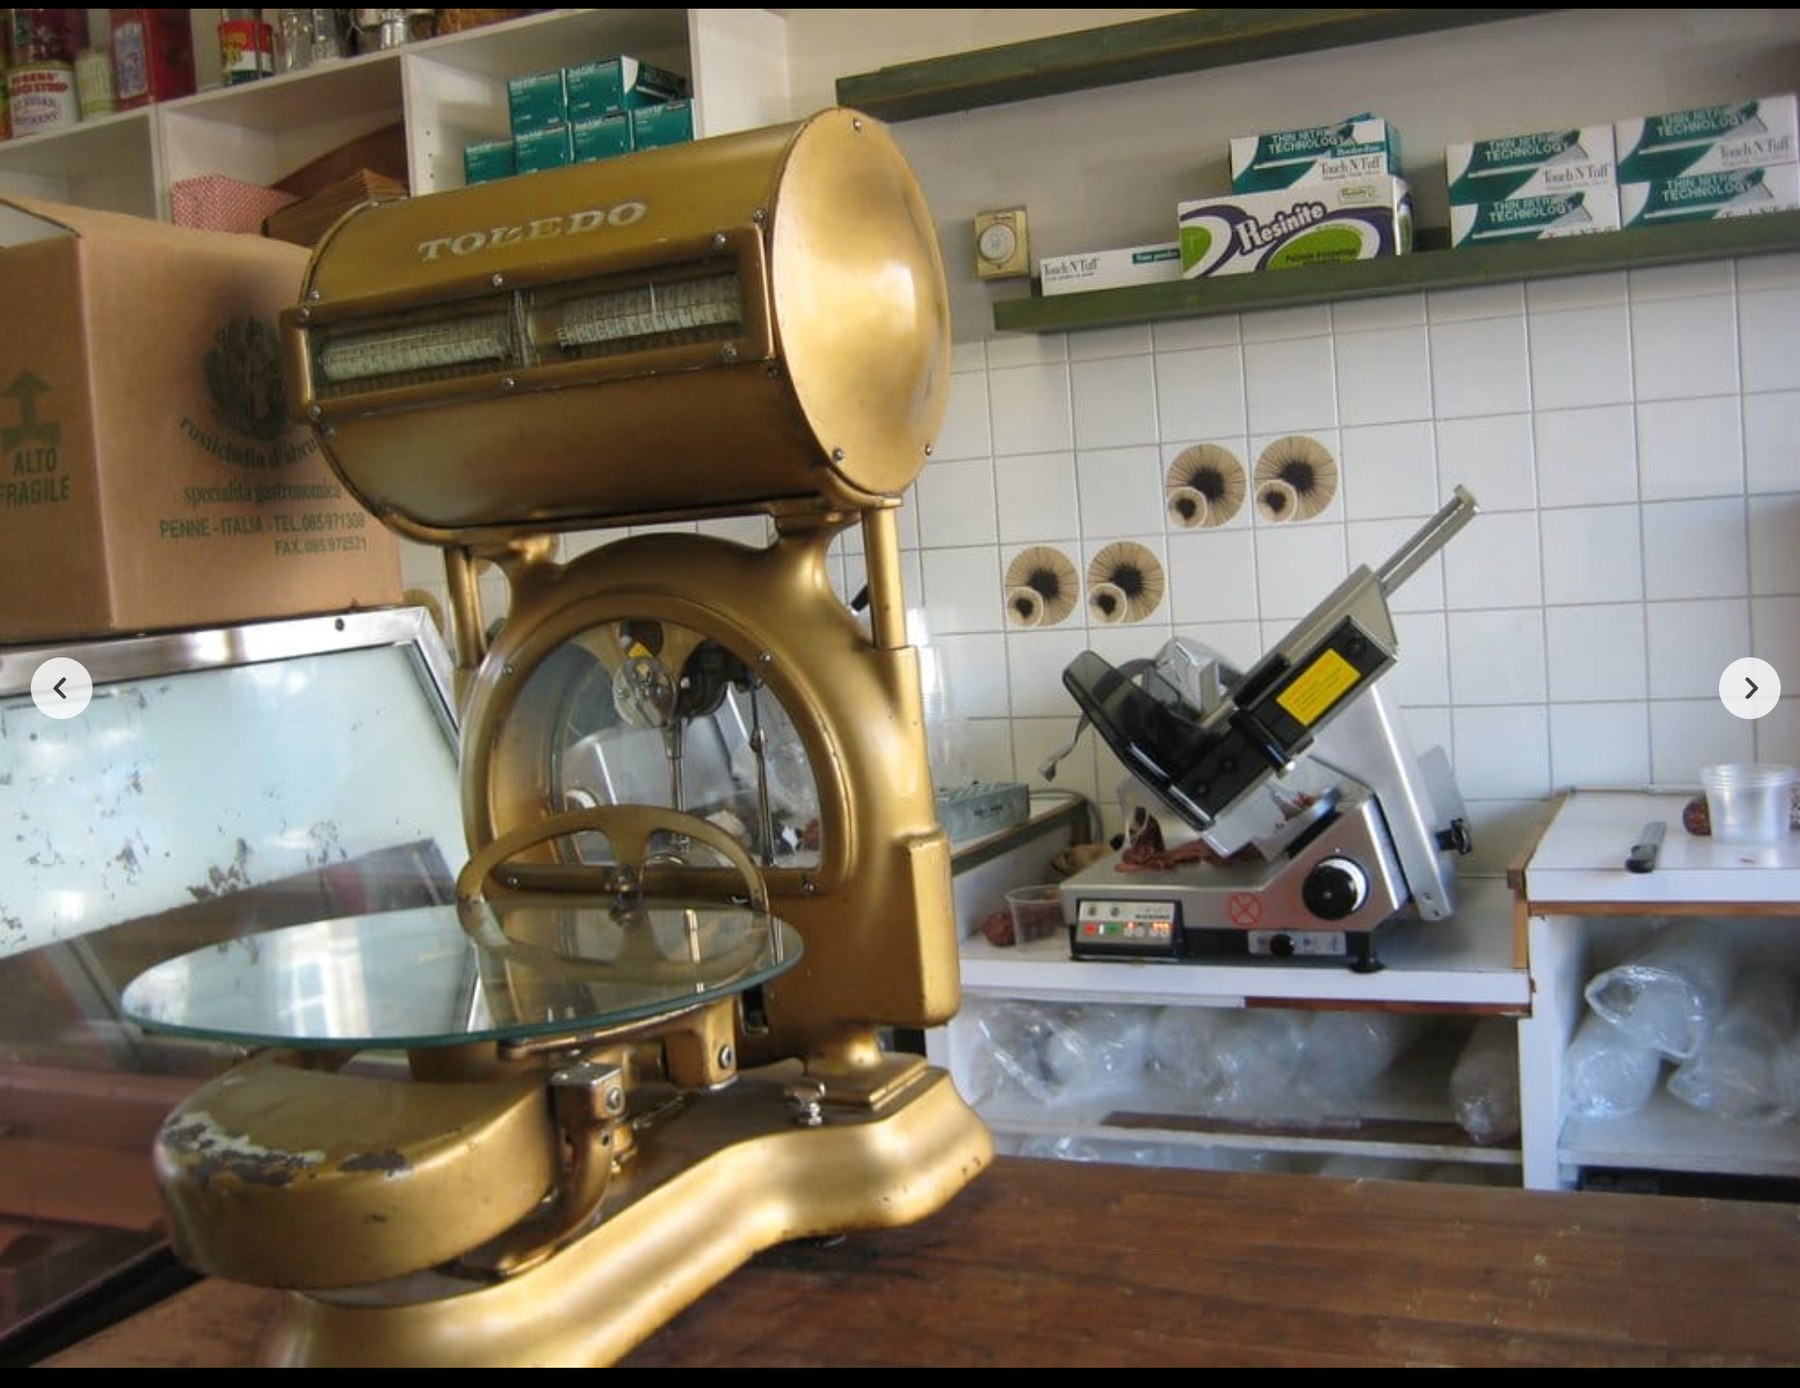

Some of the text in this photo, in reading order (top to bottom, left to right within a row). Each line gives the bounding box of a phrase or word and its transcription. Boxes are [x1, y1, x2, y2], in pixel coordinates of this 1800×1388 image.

[1656, 113, 1746, 137] TECHNOLOGY
[1485, 141, 1568, 161] TECHNOLOGY
[1662, 181, 1753, 202] TECHNOLOGY
[1488, 203, 1575, 223] TECHNOLOGY
[417, 201, 648, 262] TOLEDO
[1235, 202, 1326, 254] Resinite
[13, 447, 58, 476] ALTO
[159, 516, 211, 539] PENNE
[220, 515, 263, 536] ITALIA
